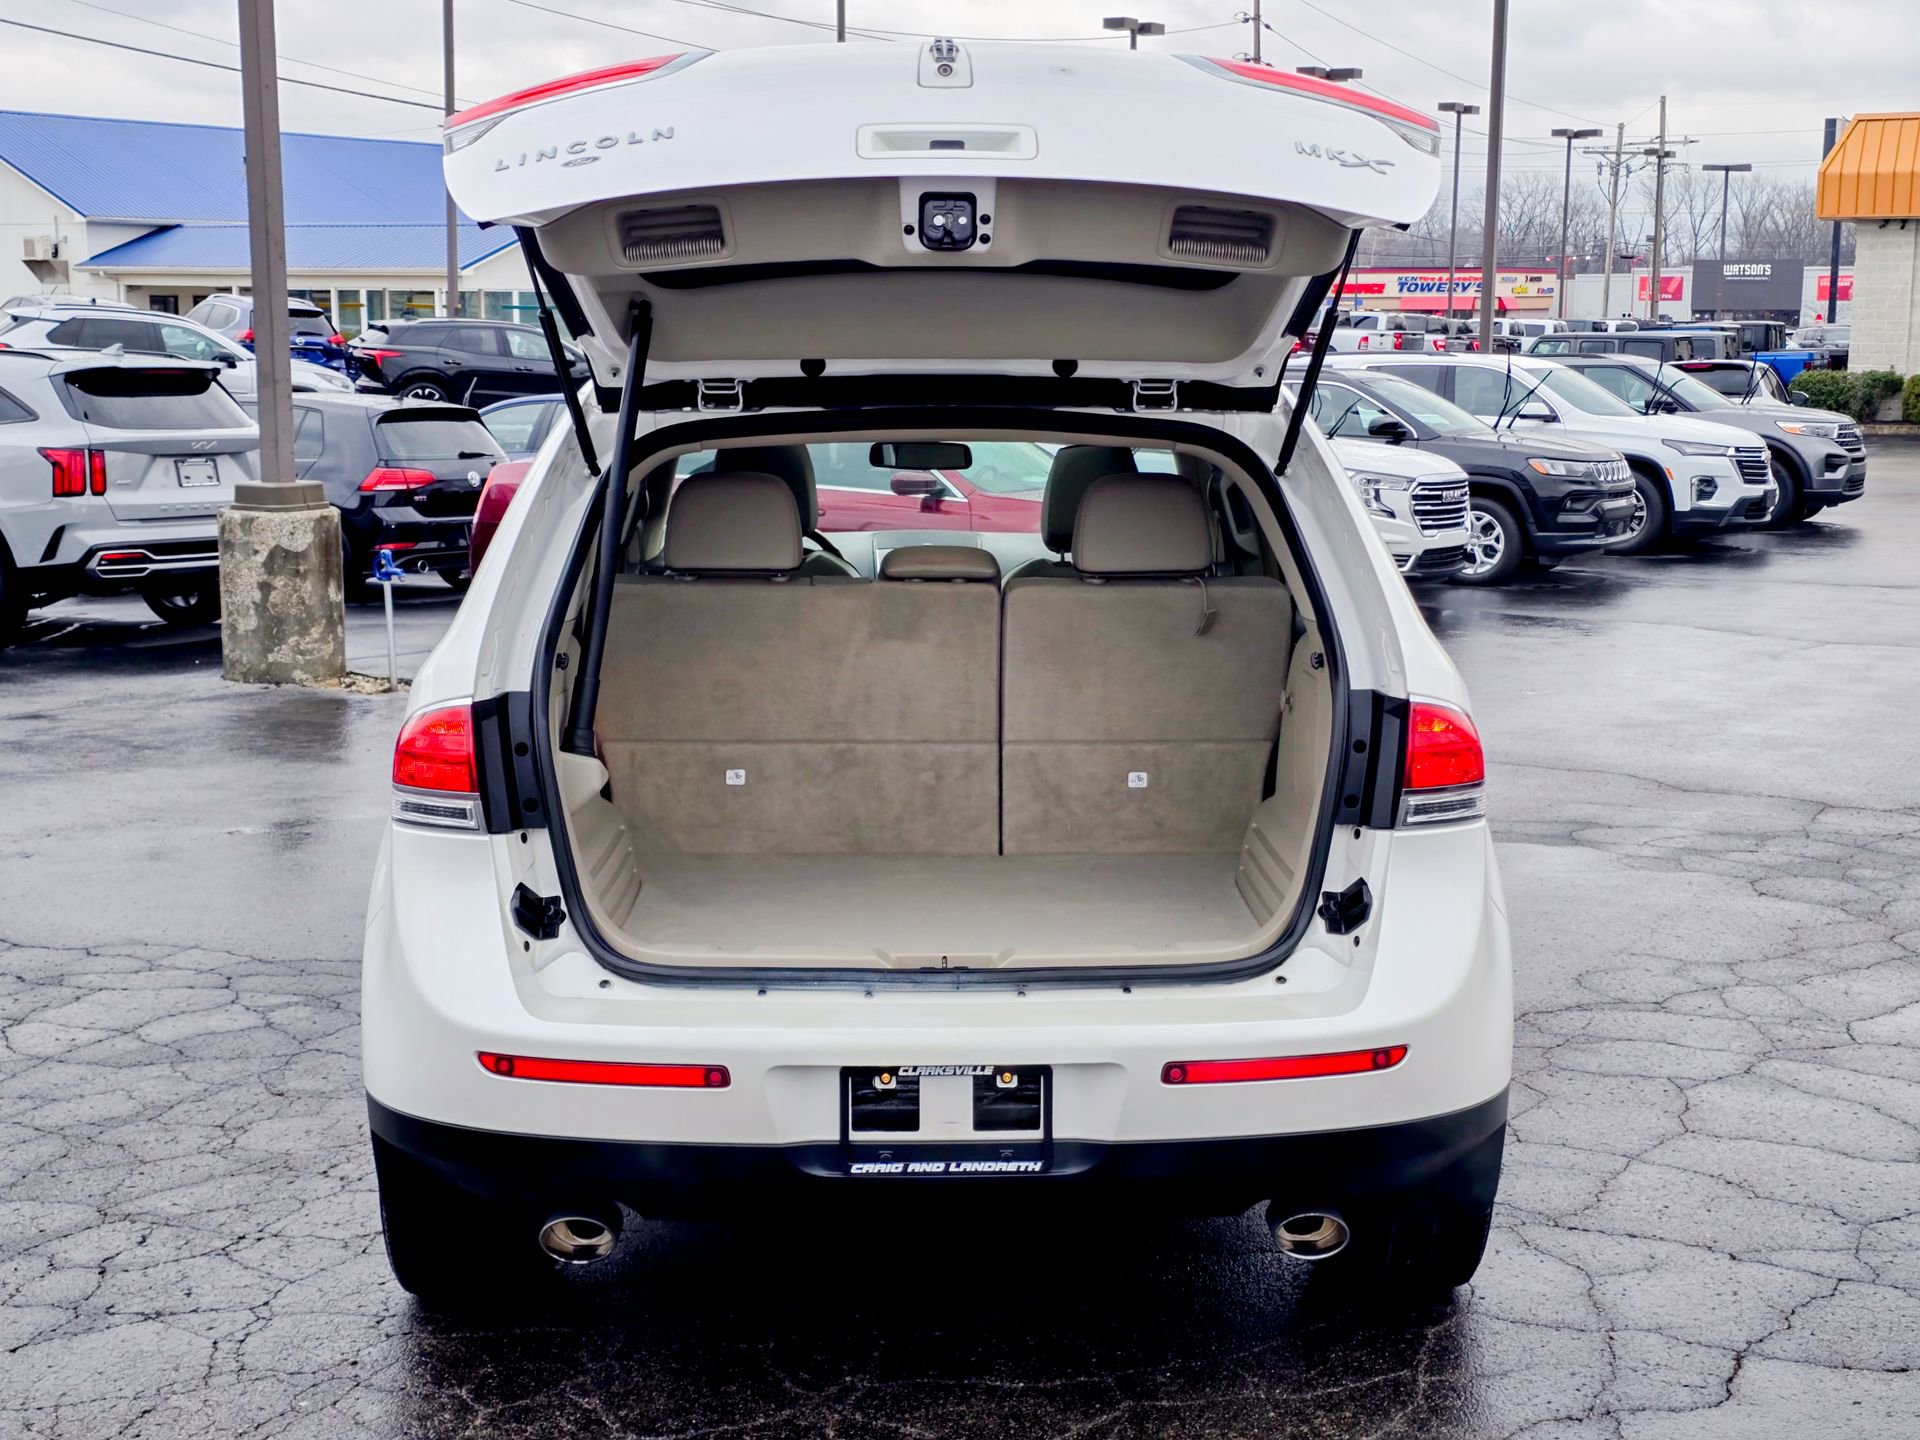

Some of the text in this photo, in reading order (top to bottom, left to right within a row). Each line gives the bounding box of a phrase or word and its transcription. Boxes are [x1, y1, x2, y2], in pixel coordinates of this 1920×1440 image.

[494, 126, 675, 172] LINCOLN
[1294, 140, 1396, 175] MKX
[1723, 264, 1772, 276] WATSON'S
[898, 1065, 995, 1076] CLARKSVILLE
[850, 1161, 1042, 1174] CRAIG AND LANDRETH
